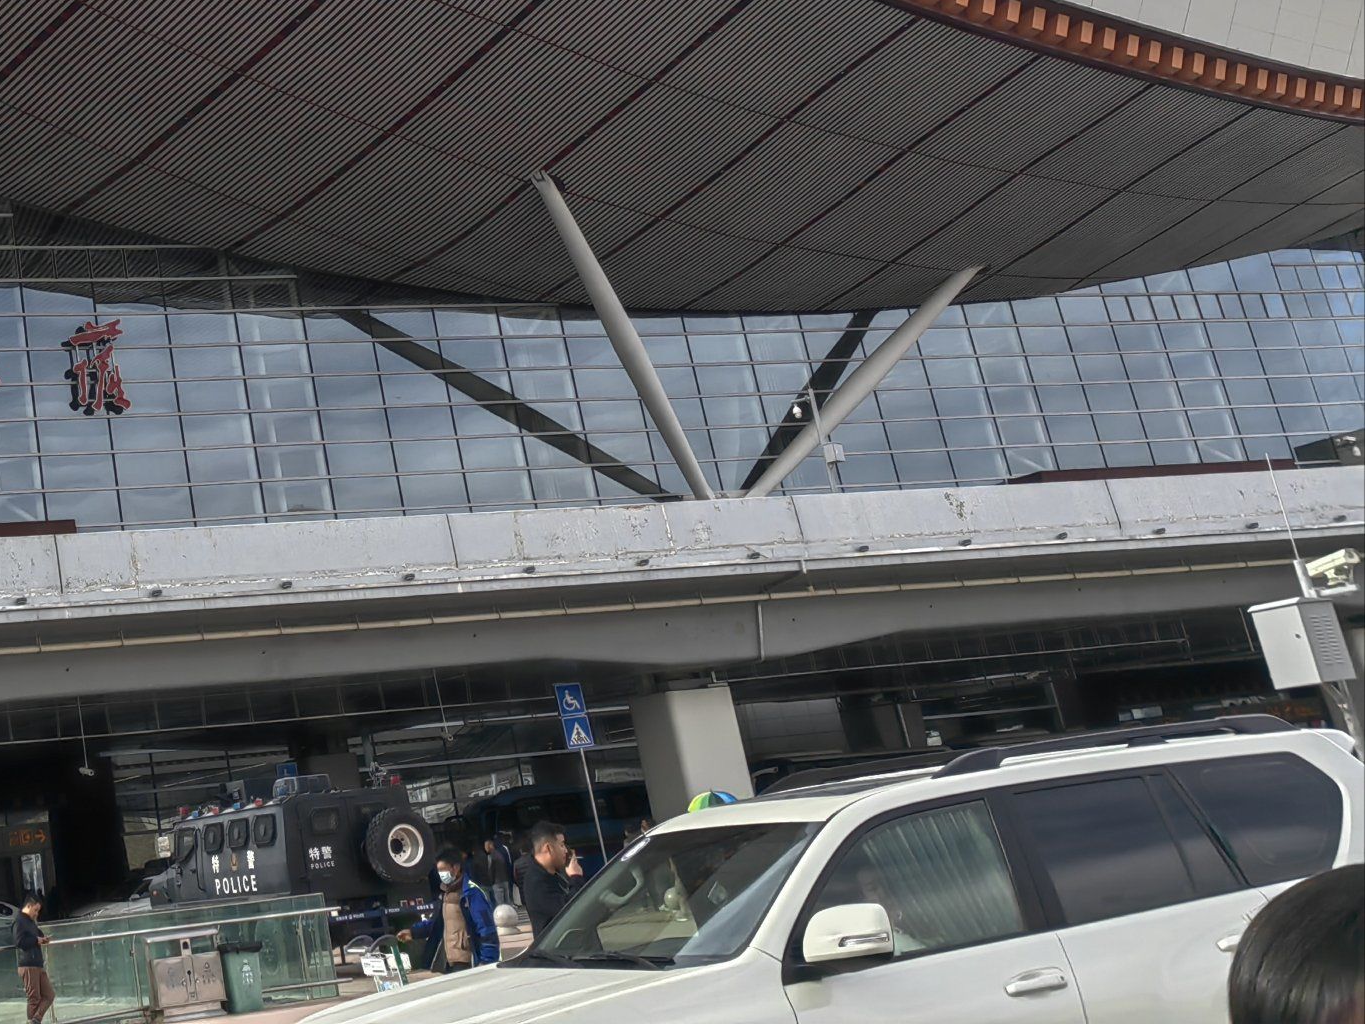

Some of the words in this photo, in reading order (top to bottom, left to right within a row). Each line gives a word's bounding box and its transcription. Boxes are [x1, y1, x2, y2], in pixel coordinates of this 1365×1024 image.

[211, 849, 256, 874] 特警
[308, 845, 333, 861] 特警
[310, 860, 335, 870] POLICE
[214, 874, 258, 895] POLICE
